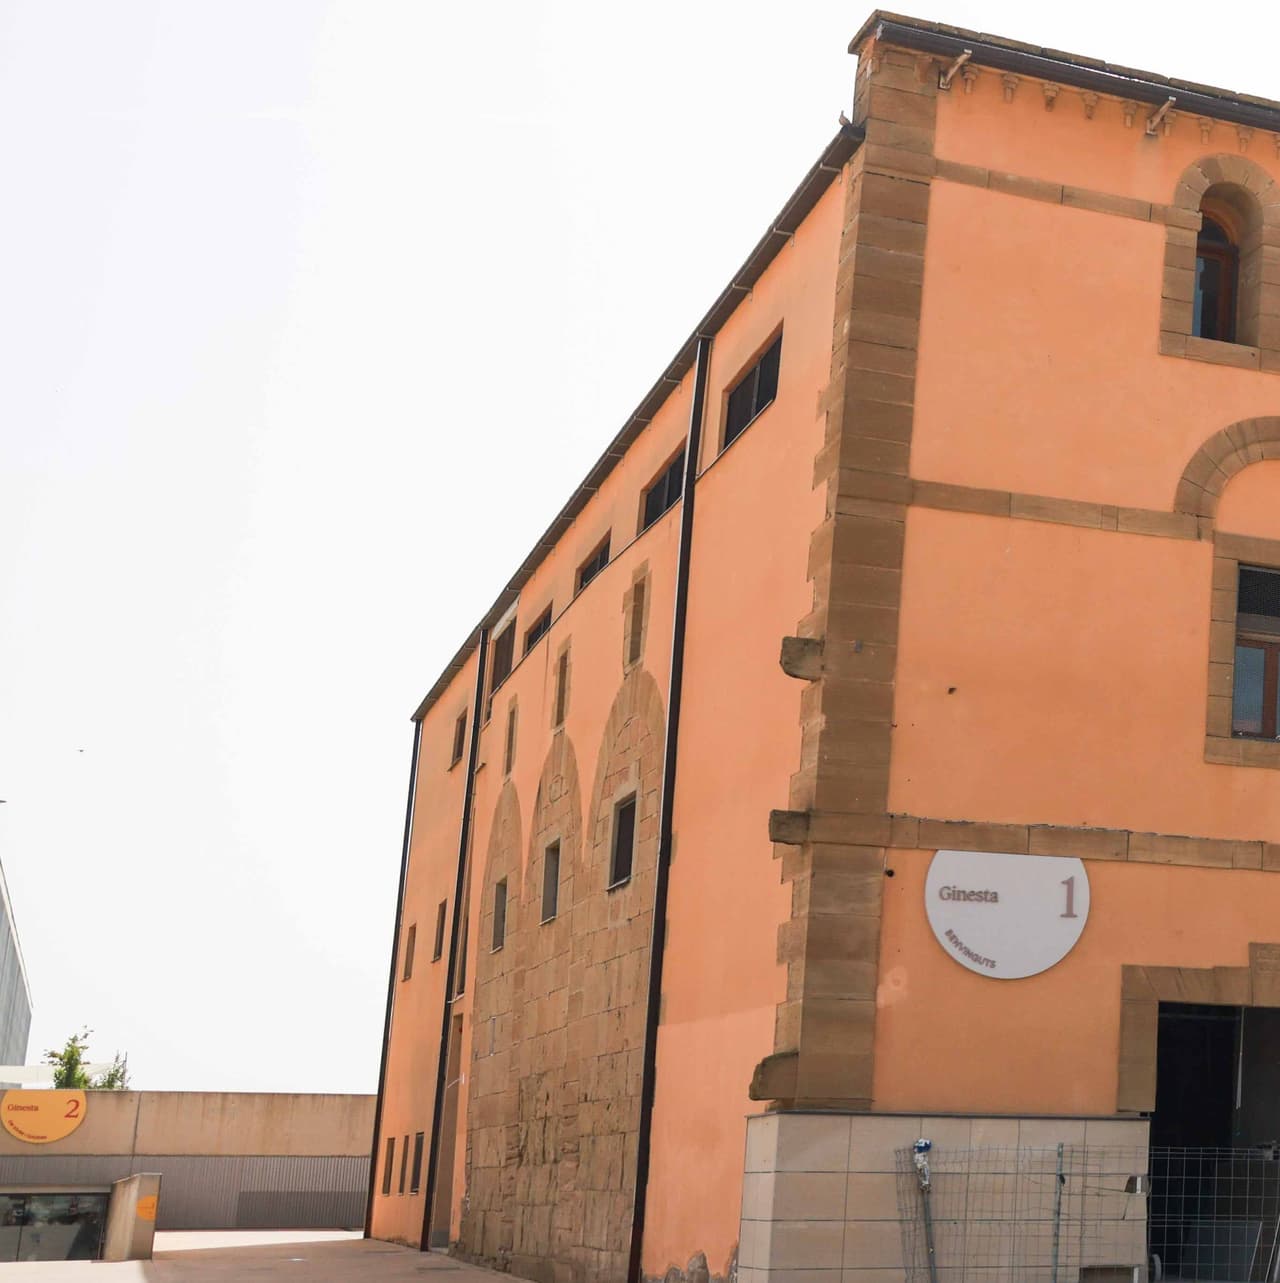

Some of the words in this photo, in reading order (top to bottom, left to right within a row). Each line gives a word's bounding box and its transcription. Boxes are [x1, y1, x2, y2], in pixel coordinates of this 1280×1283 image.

[939, 885, 999, 903] Ginesta
[1060, 875, 1078, 918] 1
[944, 928, 997, 969] BENVINGUTS
[7, 1103, 39, 1112] Ginesta
[64, 1099, 80, 1118] 2
